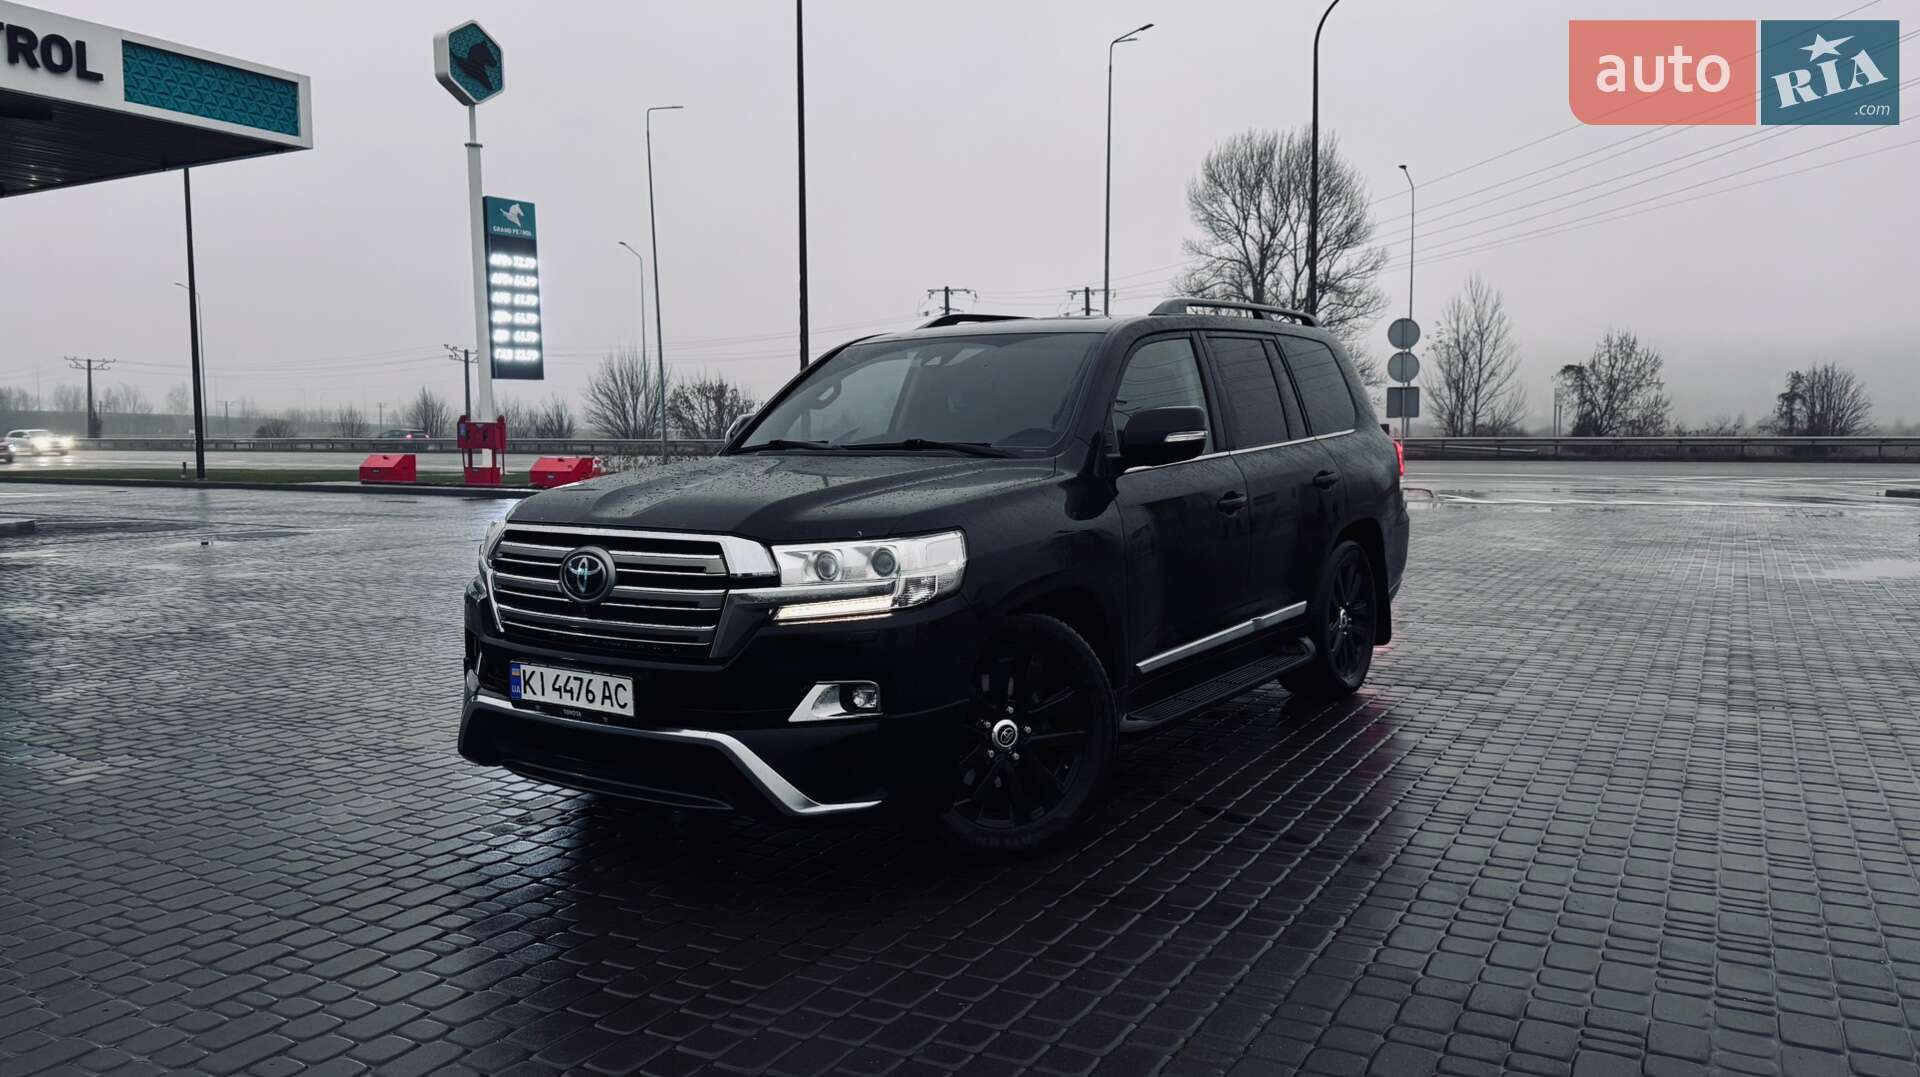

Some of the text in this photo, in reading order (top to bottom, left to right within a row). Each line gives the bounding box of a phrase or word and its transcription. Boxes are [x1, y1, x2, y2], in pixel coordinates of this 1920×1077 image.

[0, 21, 104, 82] ROL
[511, 684, 521, 694] UA
[522, 669, 628, 710] KI 4476 AC
